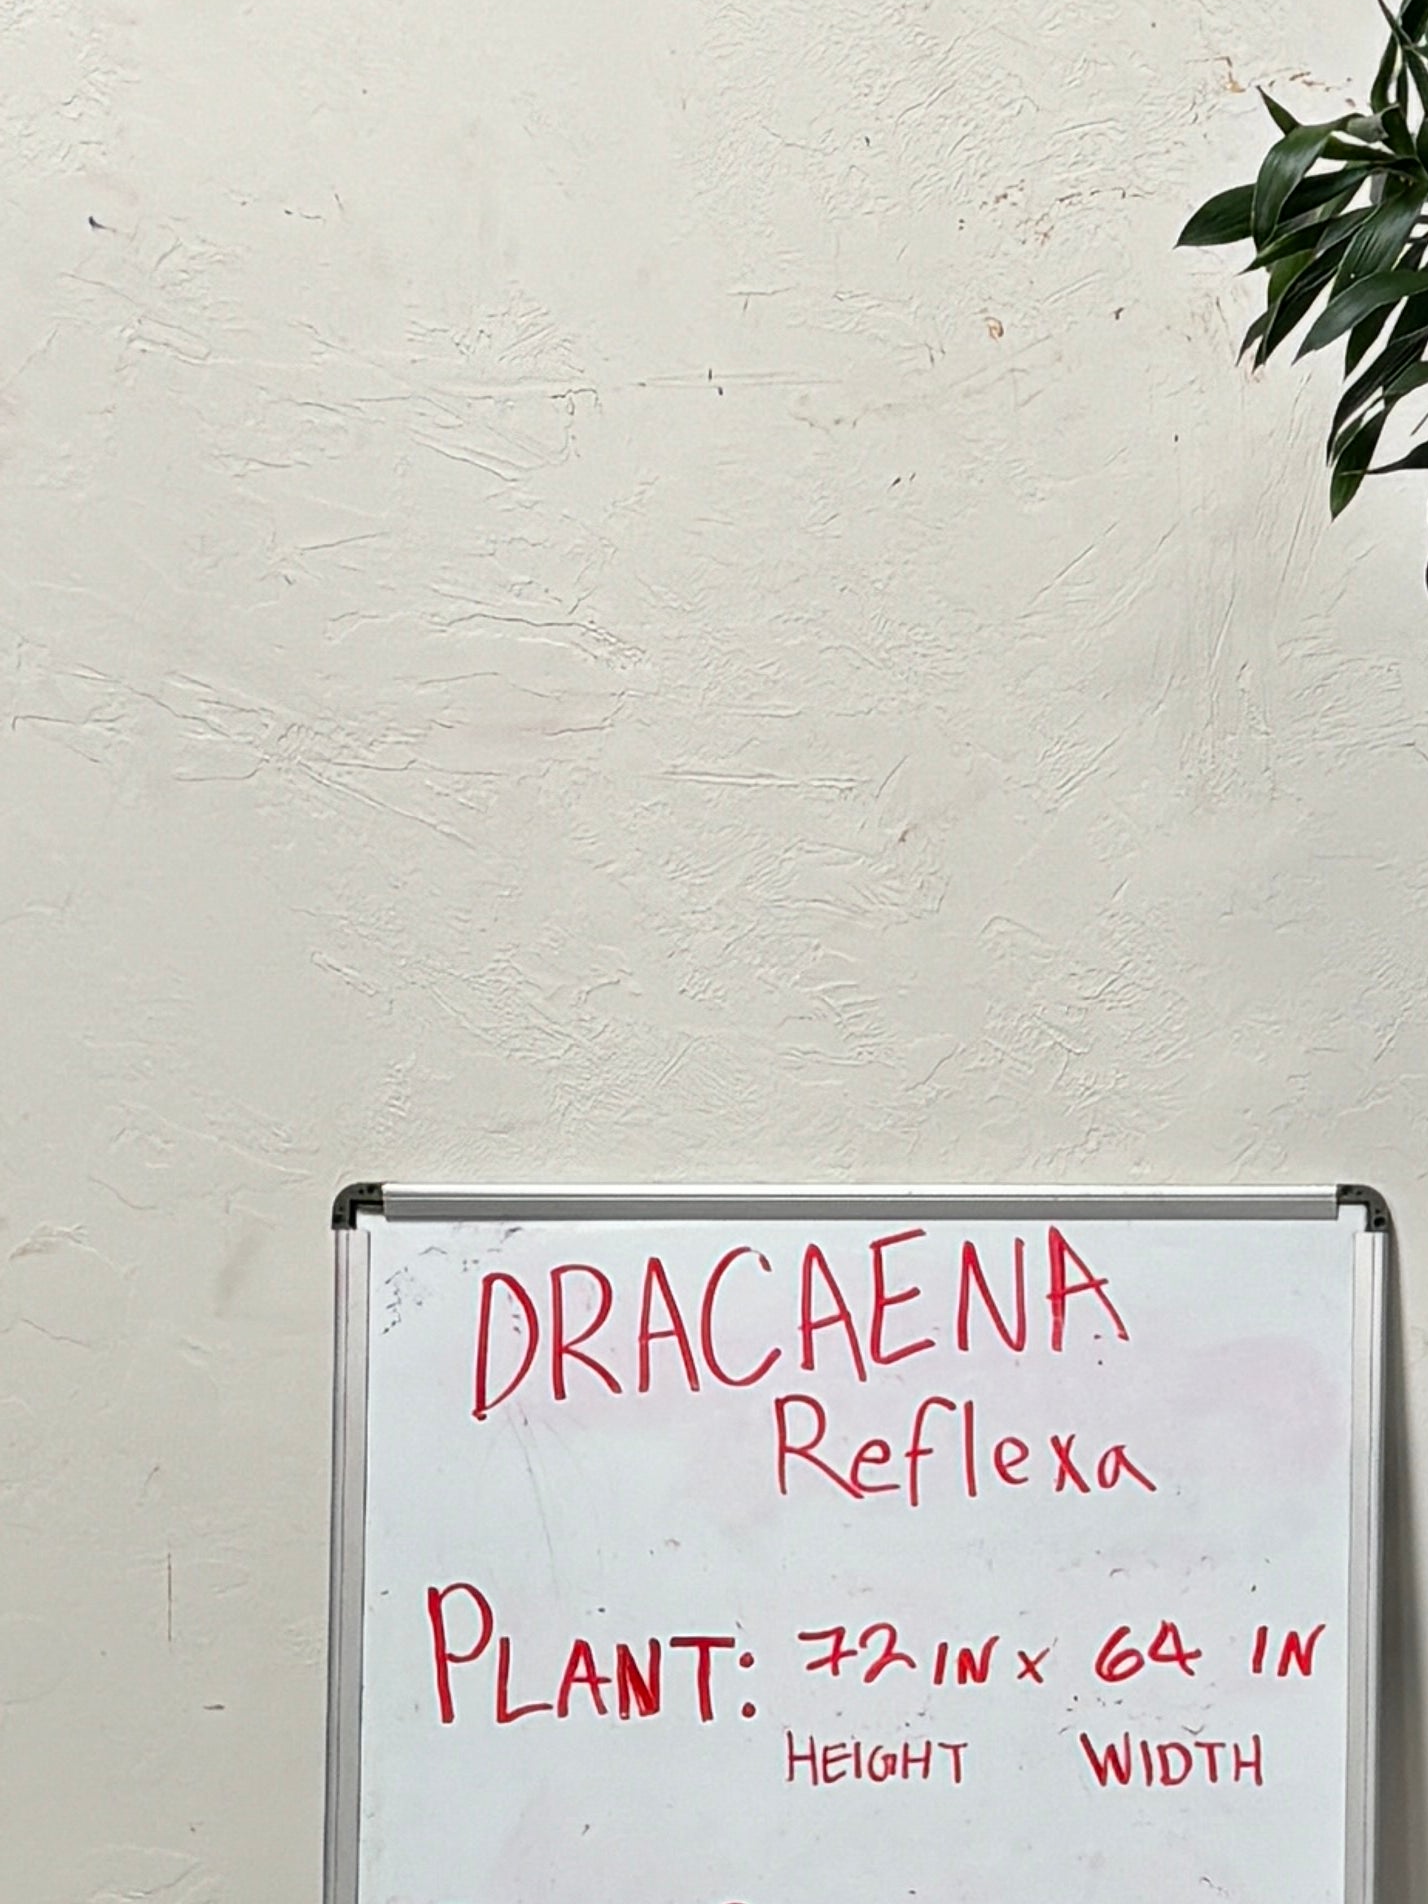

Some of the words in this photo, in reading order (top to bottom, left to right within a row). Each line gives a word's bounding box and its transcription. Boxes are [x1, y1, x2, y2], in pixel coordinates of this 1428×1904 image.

[469, 1226, 1129, 1422] DRACAENA
[773, 1394, 1157, 1507] Reflexa
[425, 1583, 756, 1725] PLANT:
[1092, 1621, 1202, 1684] 64
[1251, 1624, 1326, 1679] IN
[786, 1731, 968, 1786] HEIGHT
[1081, 1734, 1263, 1788] WIDTH
